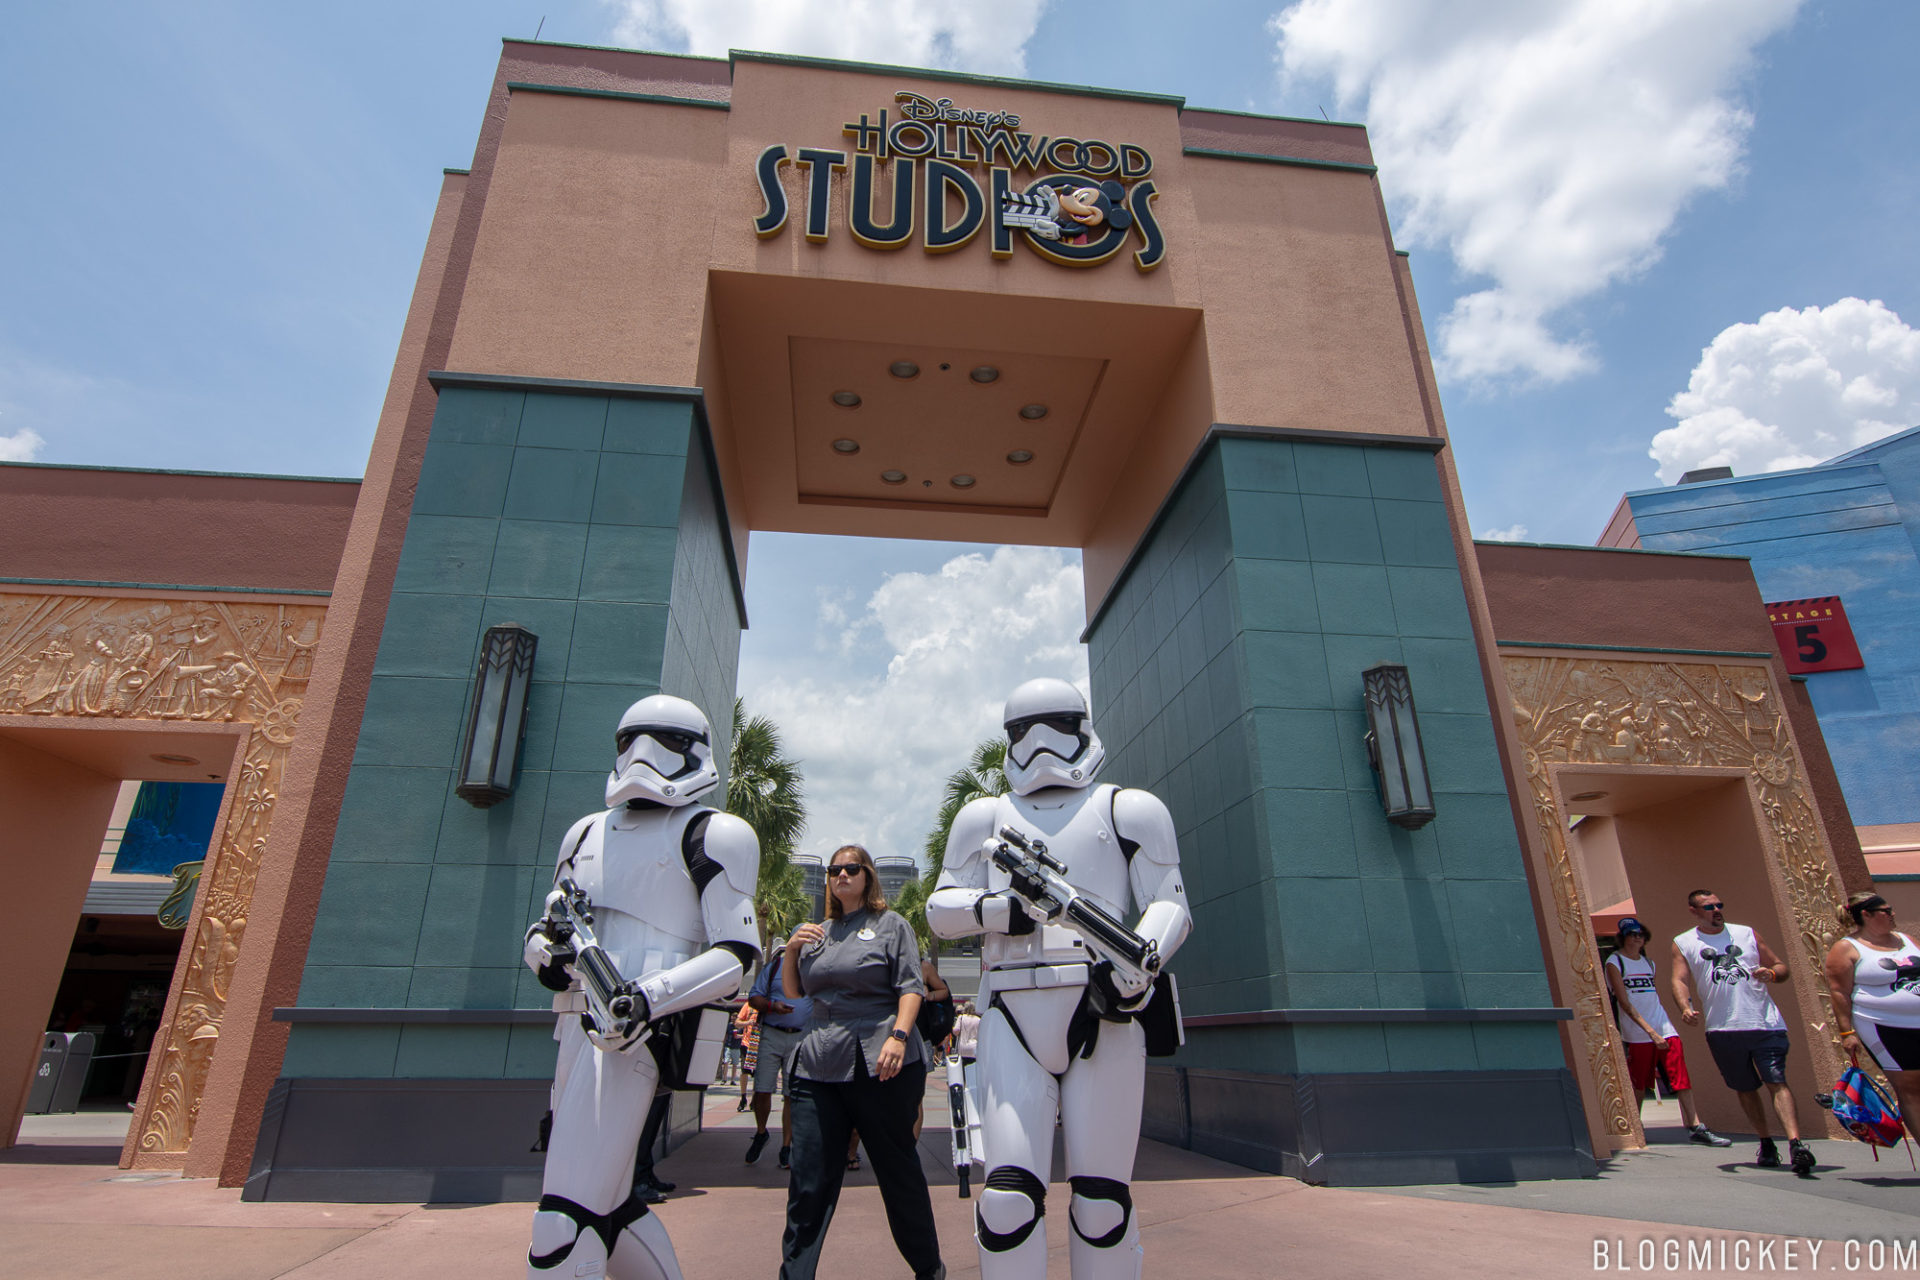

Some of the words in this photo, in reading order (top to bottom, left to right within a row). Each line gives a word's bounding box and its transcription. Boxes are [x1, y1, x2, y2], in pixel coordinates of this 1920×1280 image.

[842, 107, 1154, 182] HOLLYWOOD
[752, 143, 1168, 274] STUDIOS
[1769, 608, 1832, 621] STAGE
[1795, 625, 1827, 663] 5
